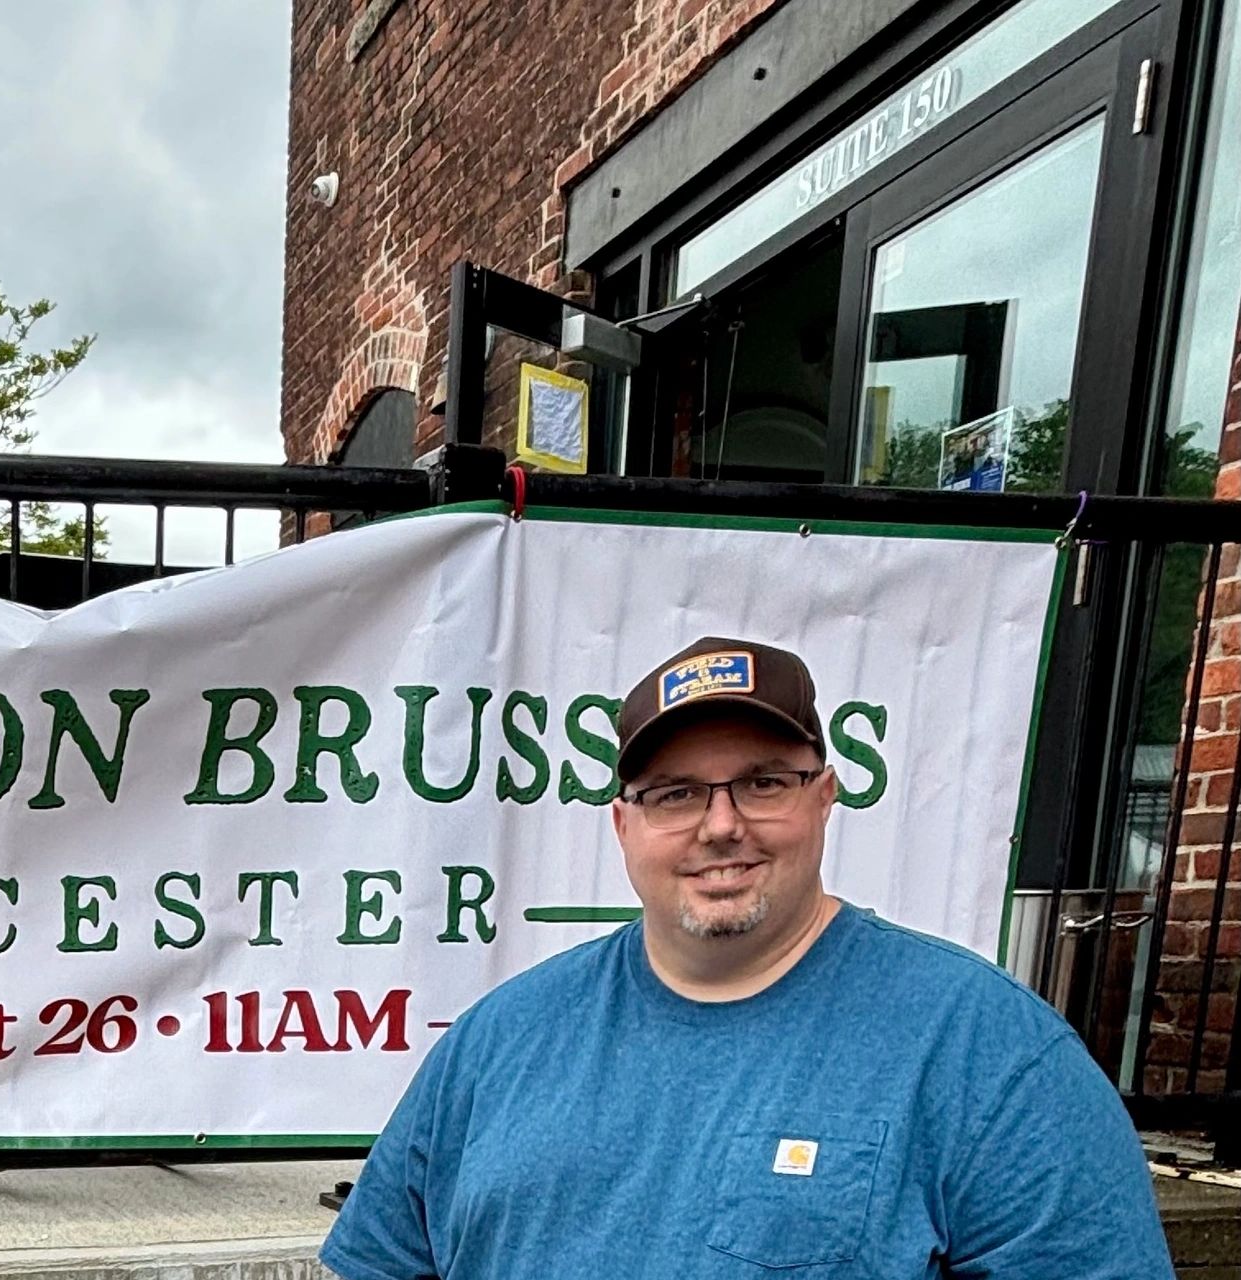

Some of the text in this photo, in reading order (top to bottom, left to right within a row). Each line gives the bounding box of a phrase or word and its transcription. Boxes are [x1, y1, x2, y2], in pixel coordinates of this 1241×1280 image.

[796, 66, 952, 209] SUITE 150
[184, 683, 889, 811] BRUSSS
[33, 993, 139, 1058] 26
[202, 989, 412, 1053] 11AM
